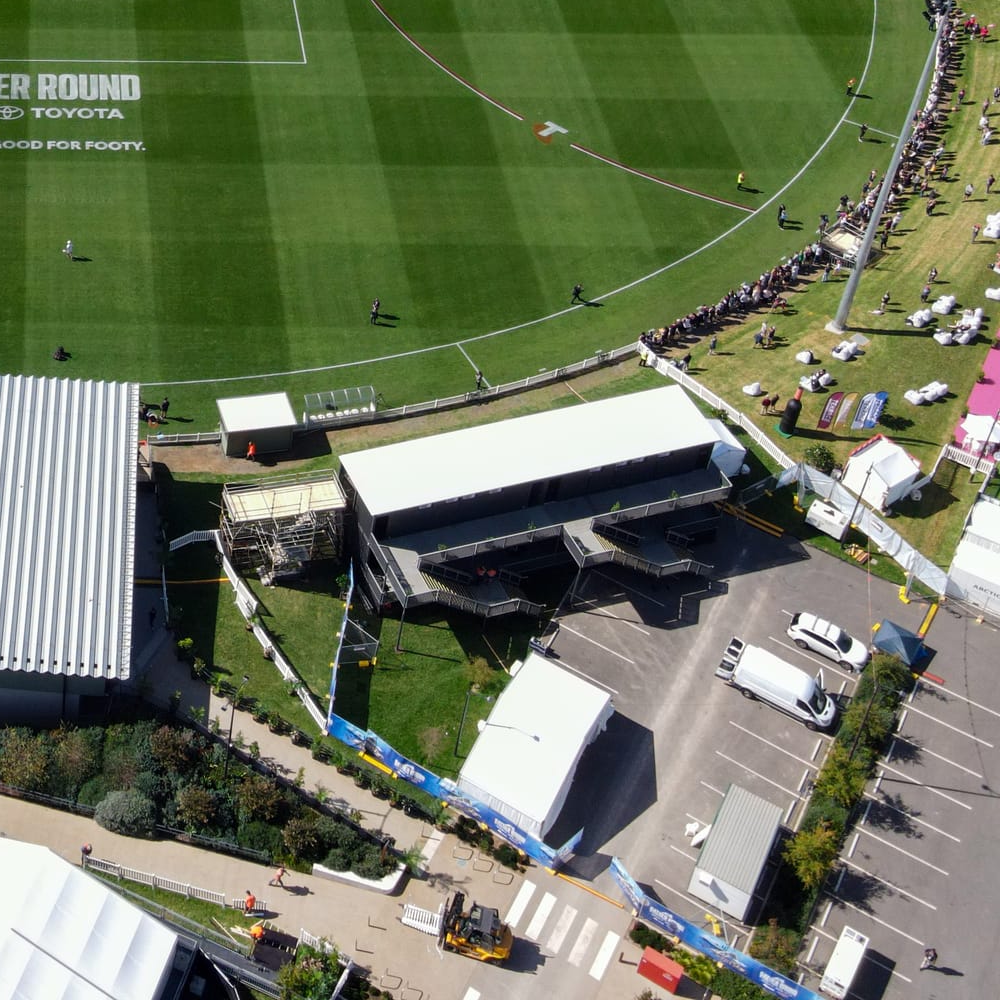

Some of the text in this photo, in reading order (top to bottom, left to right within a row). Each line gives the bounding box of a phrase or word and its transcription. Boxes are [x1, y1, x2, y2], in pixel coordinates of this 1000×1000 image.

[37, 73, 142, 101] ROUND
[31, 107, 125, 120] TOYOTA
[46, 140, 81, 151] FOR
[85, 141, 147, 151] FOOTY.
